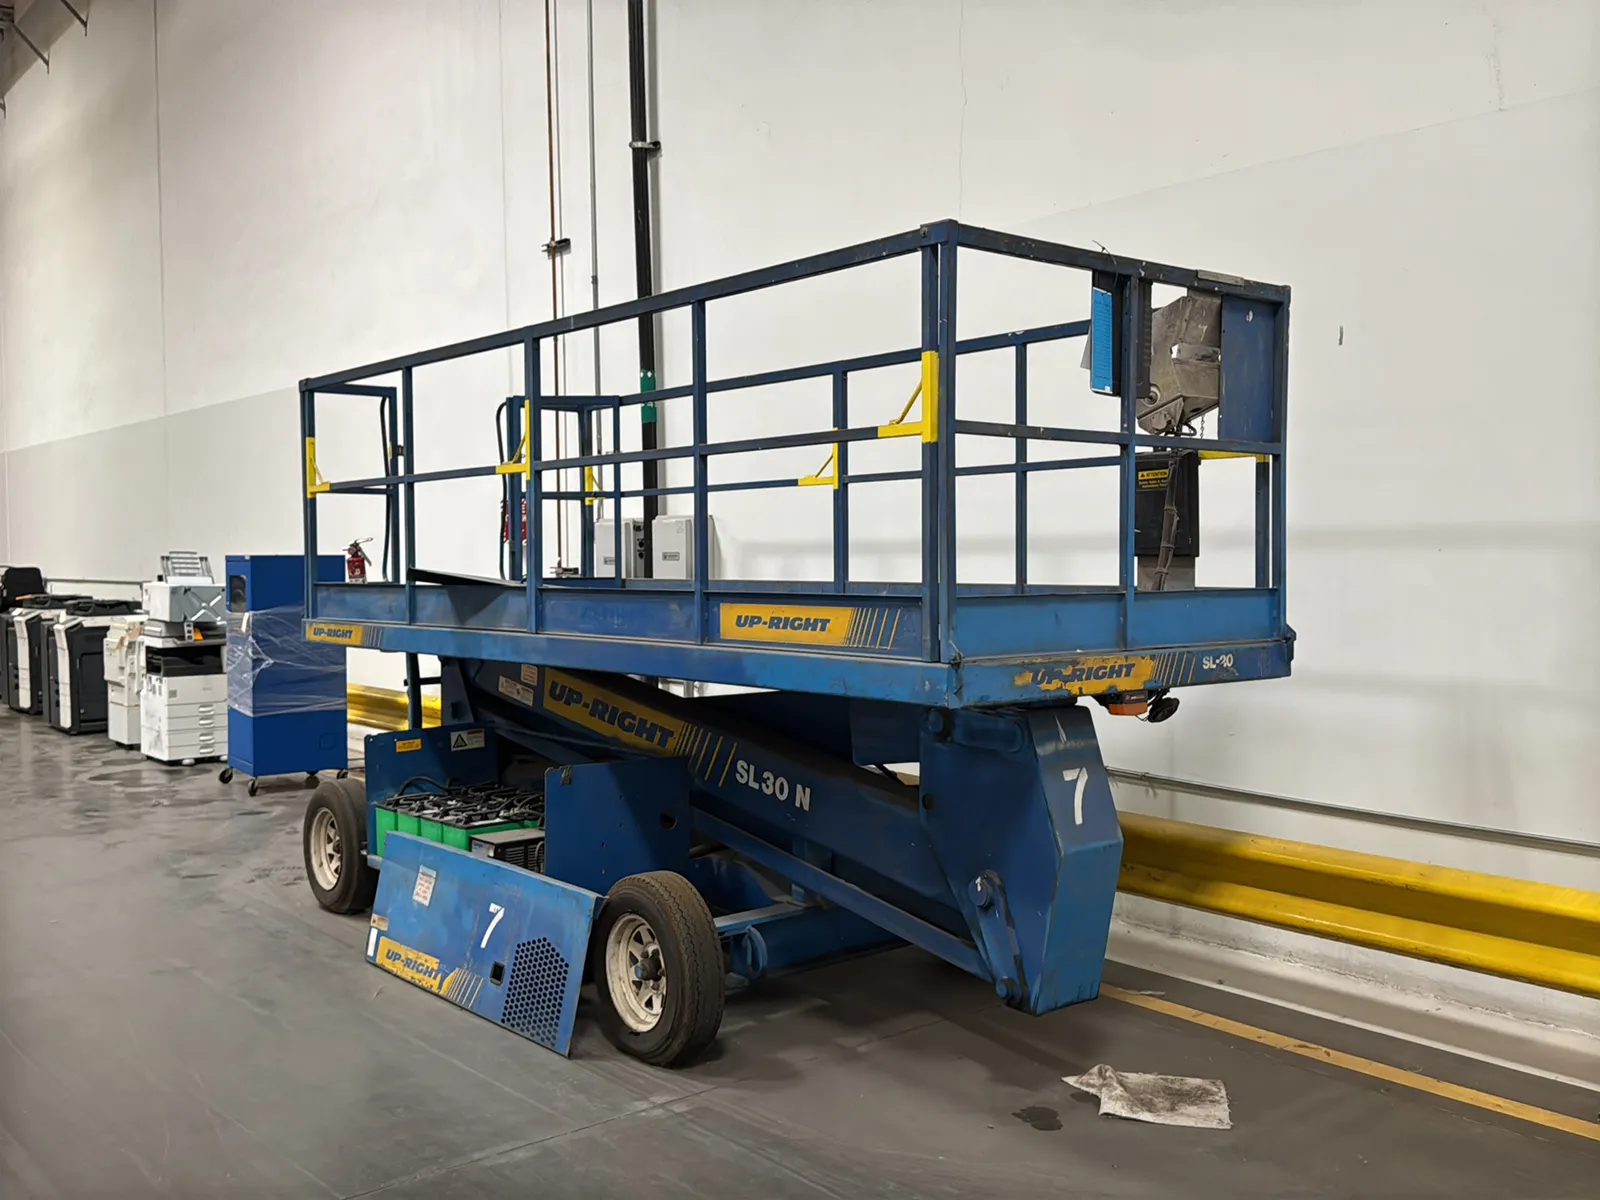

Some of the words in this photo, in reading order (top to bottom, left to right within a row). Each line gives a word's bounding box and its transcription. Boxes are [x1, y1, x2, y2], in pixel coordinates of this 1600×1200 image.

[313, 627, 353, 639] UP-RIGHT
[735, 604, 830, 633] UP-RIGHT
[549, 680, 675, 749] UP-RIGHT
[735, 759, 789, 801] SL30
[794, 783, 811, 812] N
[1062, 766, 1088, 825] 7
[480, 902, 505, 949] 7
